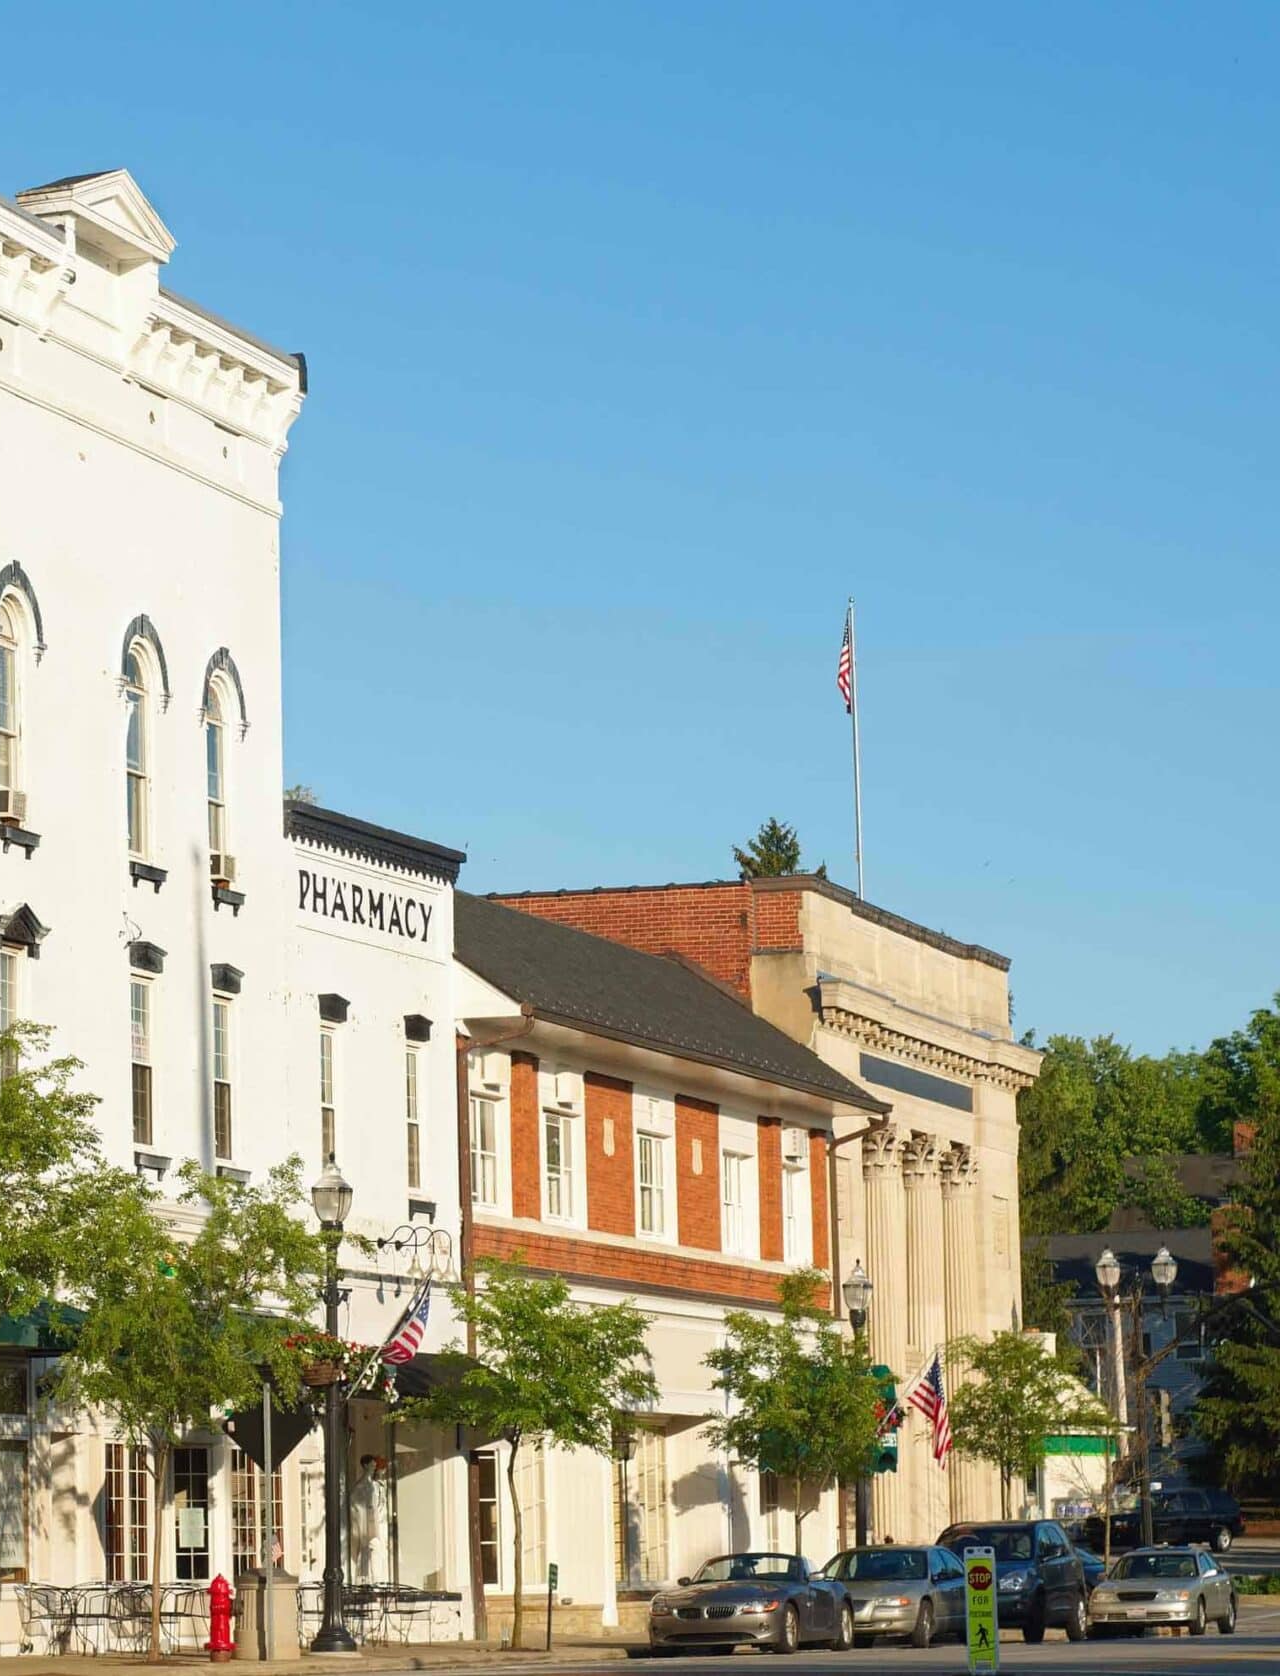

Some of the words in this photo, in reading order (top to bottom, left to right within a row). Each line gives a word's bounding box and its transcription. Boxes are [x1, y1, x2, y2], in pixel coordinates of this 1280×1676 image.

[298, 869, 433, 942] PHARMACY
[969, 1573, 991, 1584] STOP
[973, 1596, 988, 1604] FOR
